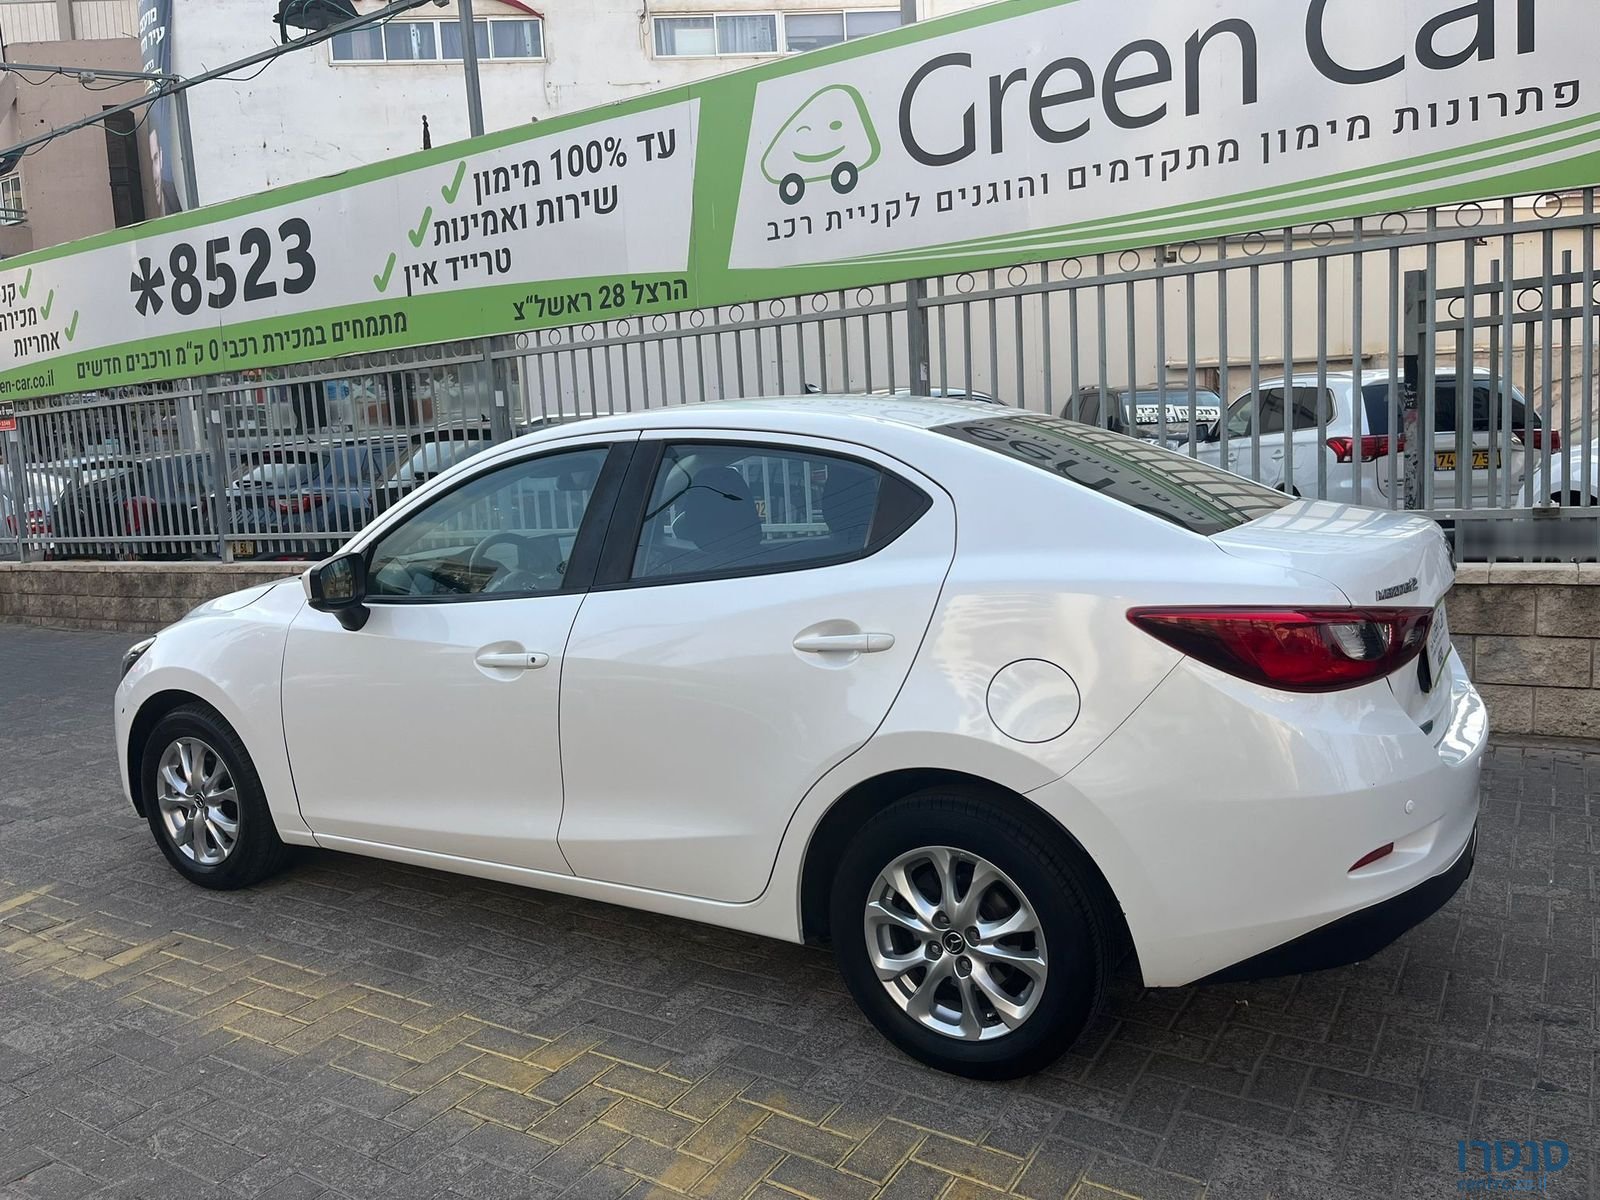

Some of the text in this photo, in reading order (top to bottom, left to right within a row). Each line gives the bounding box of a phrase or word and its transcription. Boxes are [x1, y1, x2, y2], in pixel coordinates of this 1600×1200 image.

[898, 18, 1257, 167] Green
[473, 128, 676, 206] עד 100% מימון
[767, 79, 1580, 241] פתרונות מימון מתקדמים והוגנים לקניית רכב
[433, 184, 618, 247] שירות ואמינות
[403, 247, 512, 297] טרייד אין
[598, 283, 626, 310] 28
[631, 278, 688, 305] הרצל
[0, 307, 37, 332] מכירה
[332, 311, 407, 343] מתמחים
[13, 331, 60, 358] אחריות
[208, 338, 219, 361] 0
[222, 336, 258, 360] רכבי
[262, 325, 327, 354] במכירת
[76, 356, 122, 380] חדשים
[125, 349, 171, 373] ורכבים
